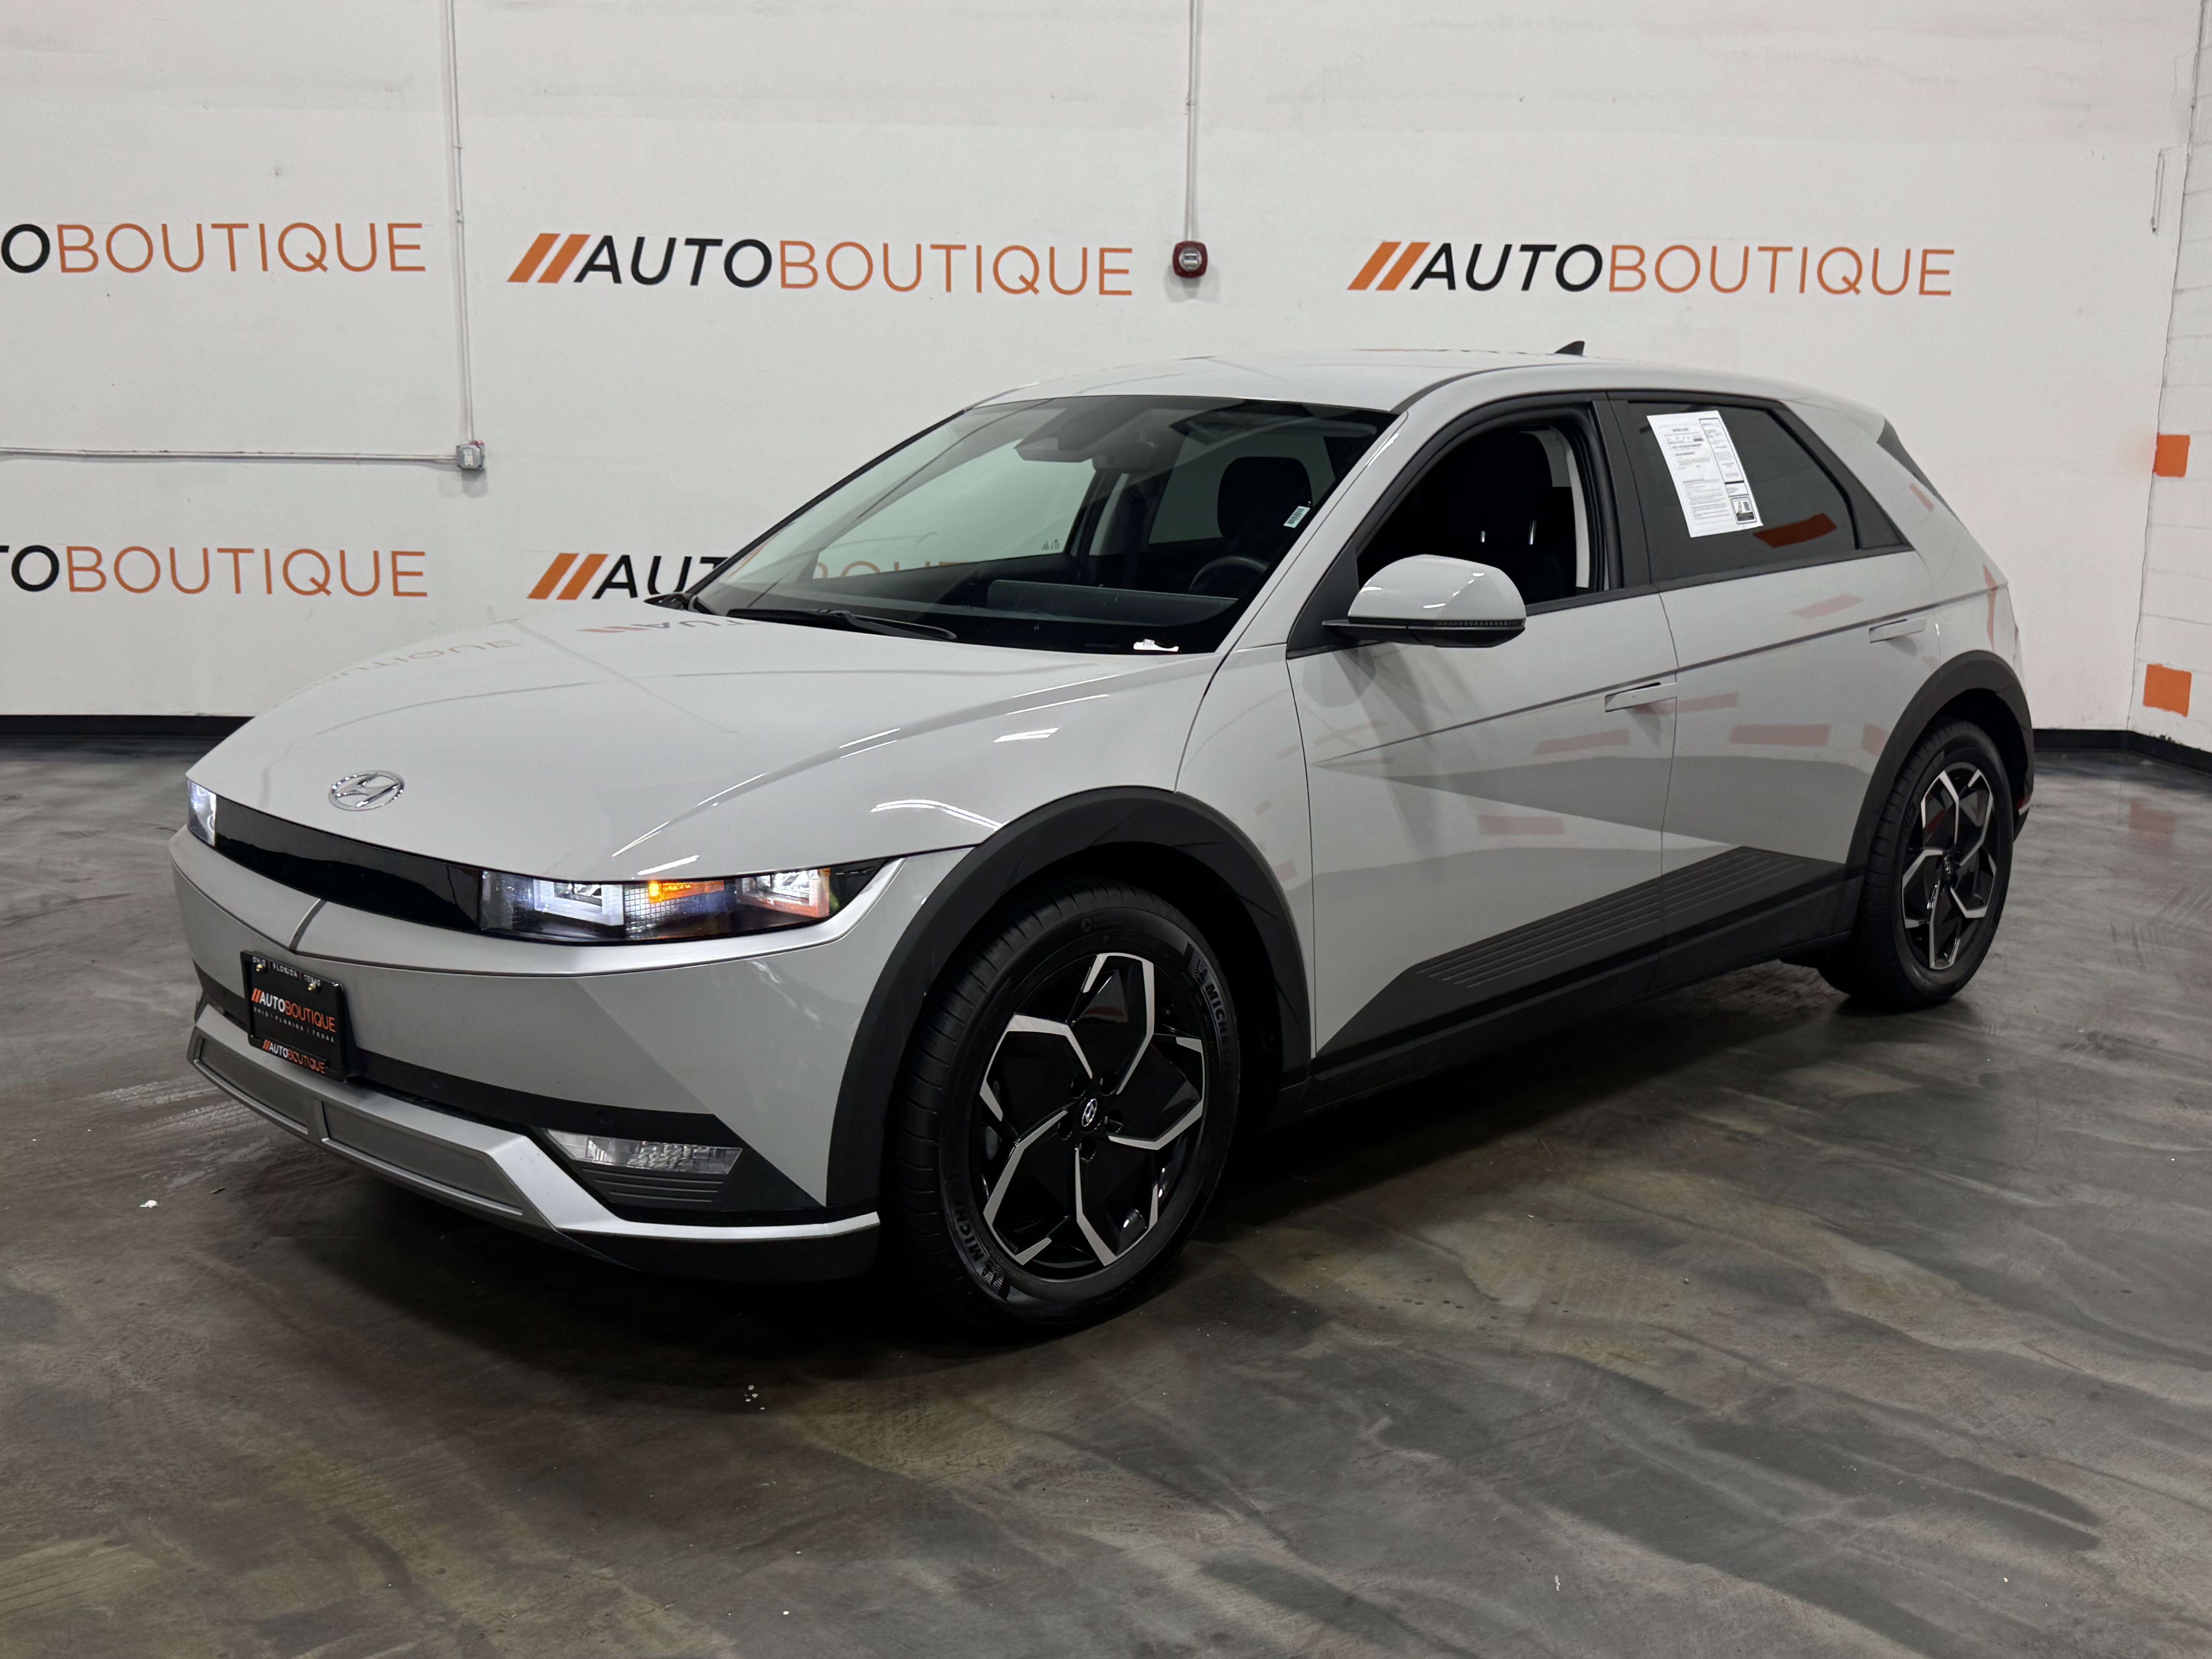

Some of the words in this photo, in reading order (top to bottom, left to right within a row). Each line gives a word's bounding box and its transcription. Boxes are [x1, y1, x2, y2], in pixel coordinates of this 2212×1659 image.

[574, 235, 1133, 295] AUTOBOUTIQUE
[1410, 243, 1954, 295] AUTOBOUTIQUE
[0, 545, 427, 596] OBOUTIQUE
[258, 991, 337, 1033] AUTOBOUTIQUE
[1205, 984, 1232, 1069] MICHEL
[268, 1042, 325, 1074] AUTOBOUTIQUE
